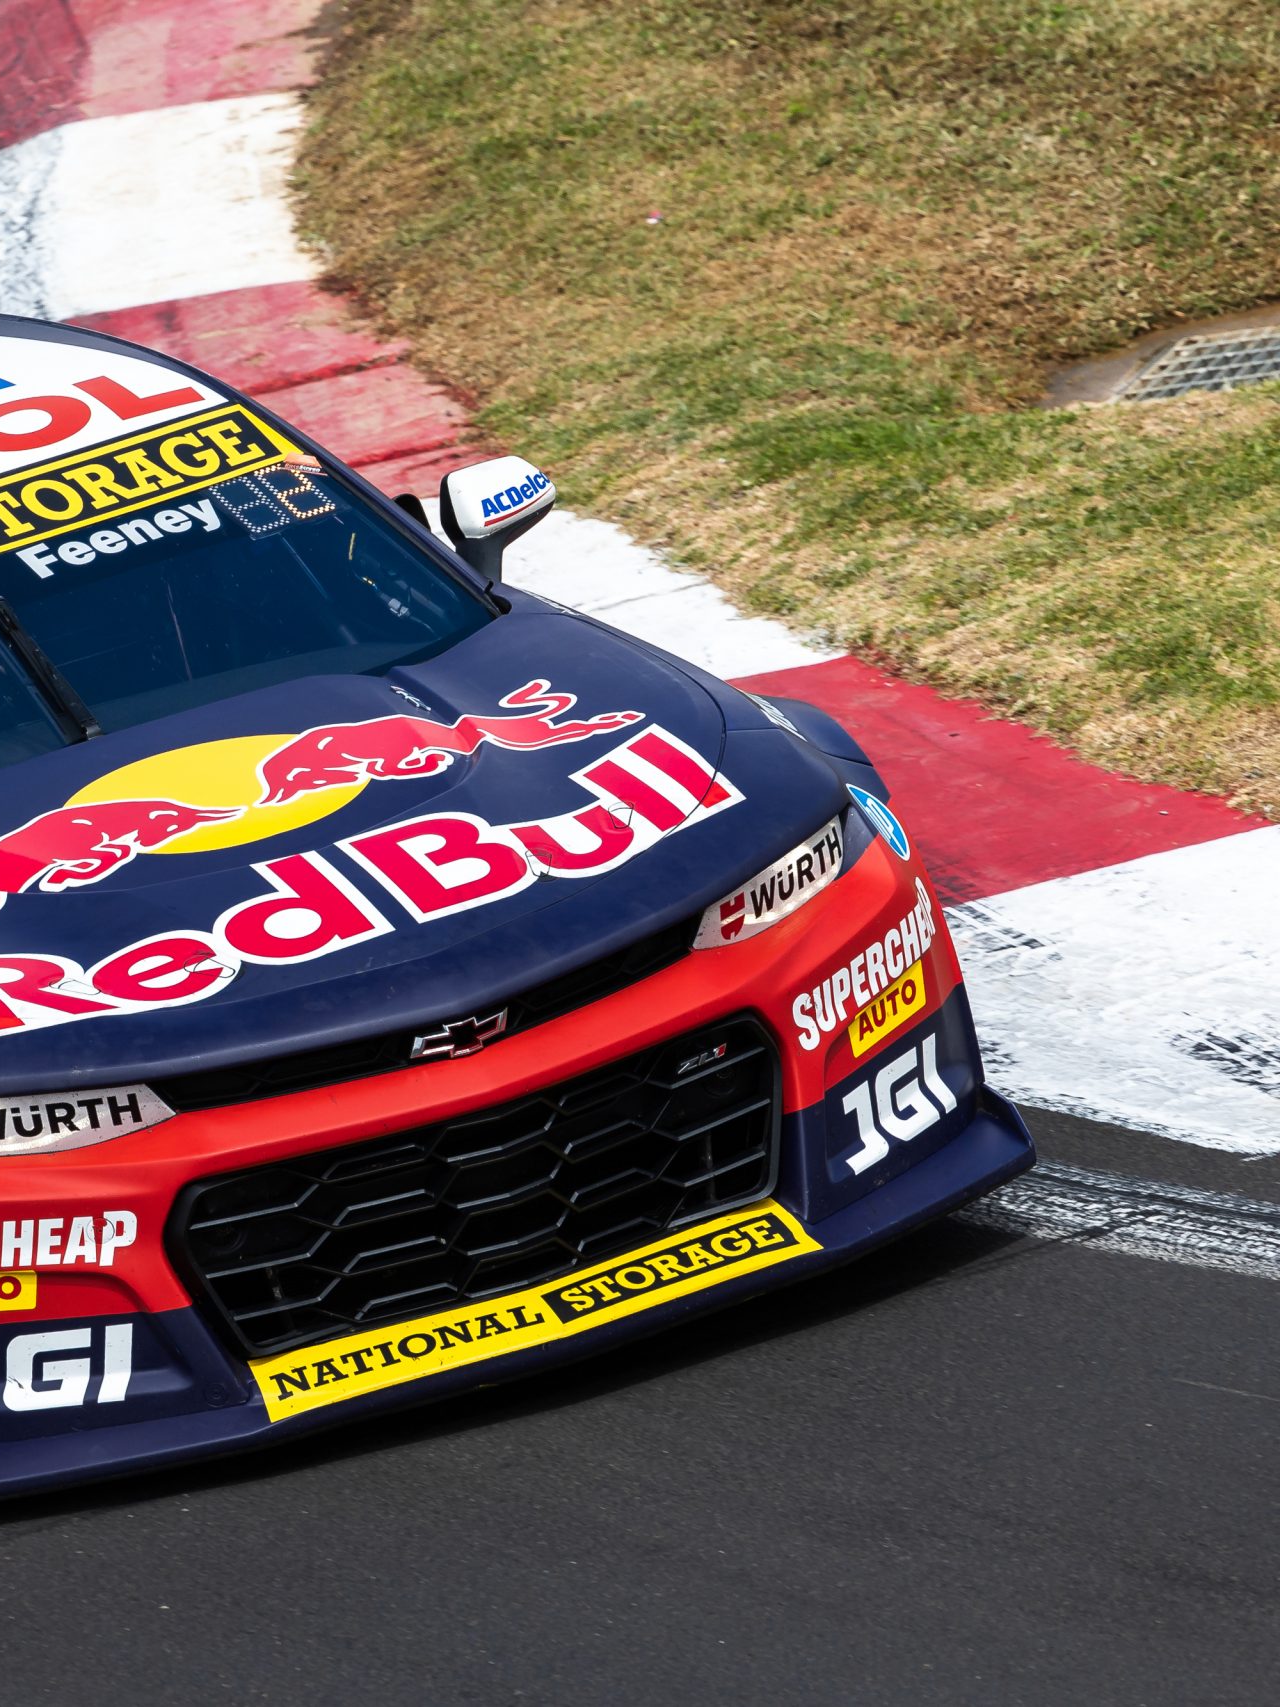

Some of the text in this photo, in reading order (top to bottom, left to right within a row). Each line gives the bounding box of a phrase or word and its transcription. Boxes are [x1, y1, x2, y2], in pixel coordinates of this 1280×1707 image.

[15, 490, 222, 579] Feeney
[750, 825, 843, 919] WÜRTH
[792, 876, 937, 1052] SUPERCHEAP
[858, 979, 917, 1042] AUTO
[842, 1033, 957, 1176] JGI
[271, 1218, 785, 1400] NATIONAL STORAGE
